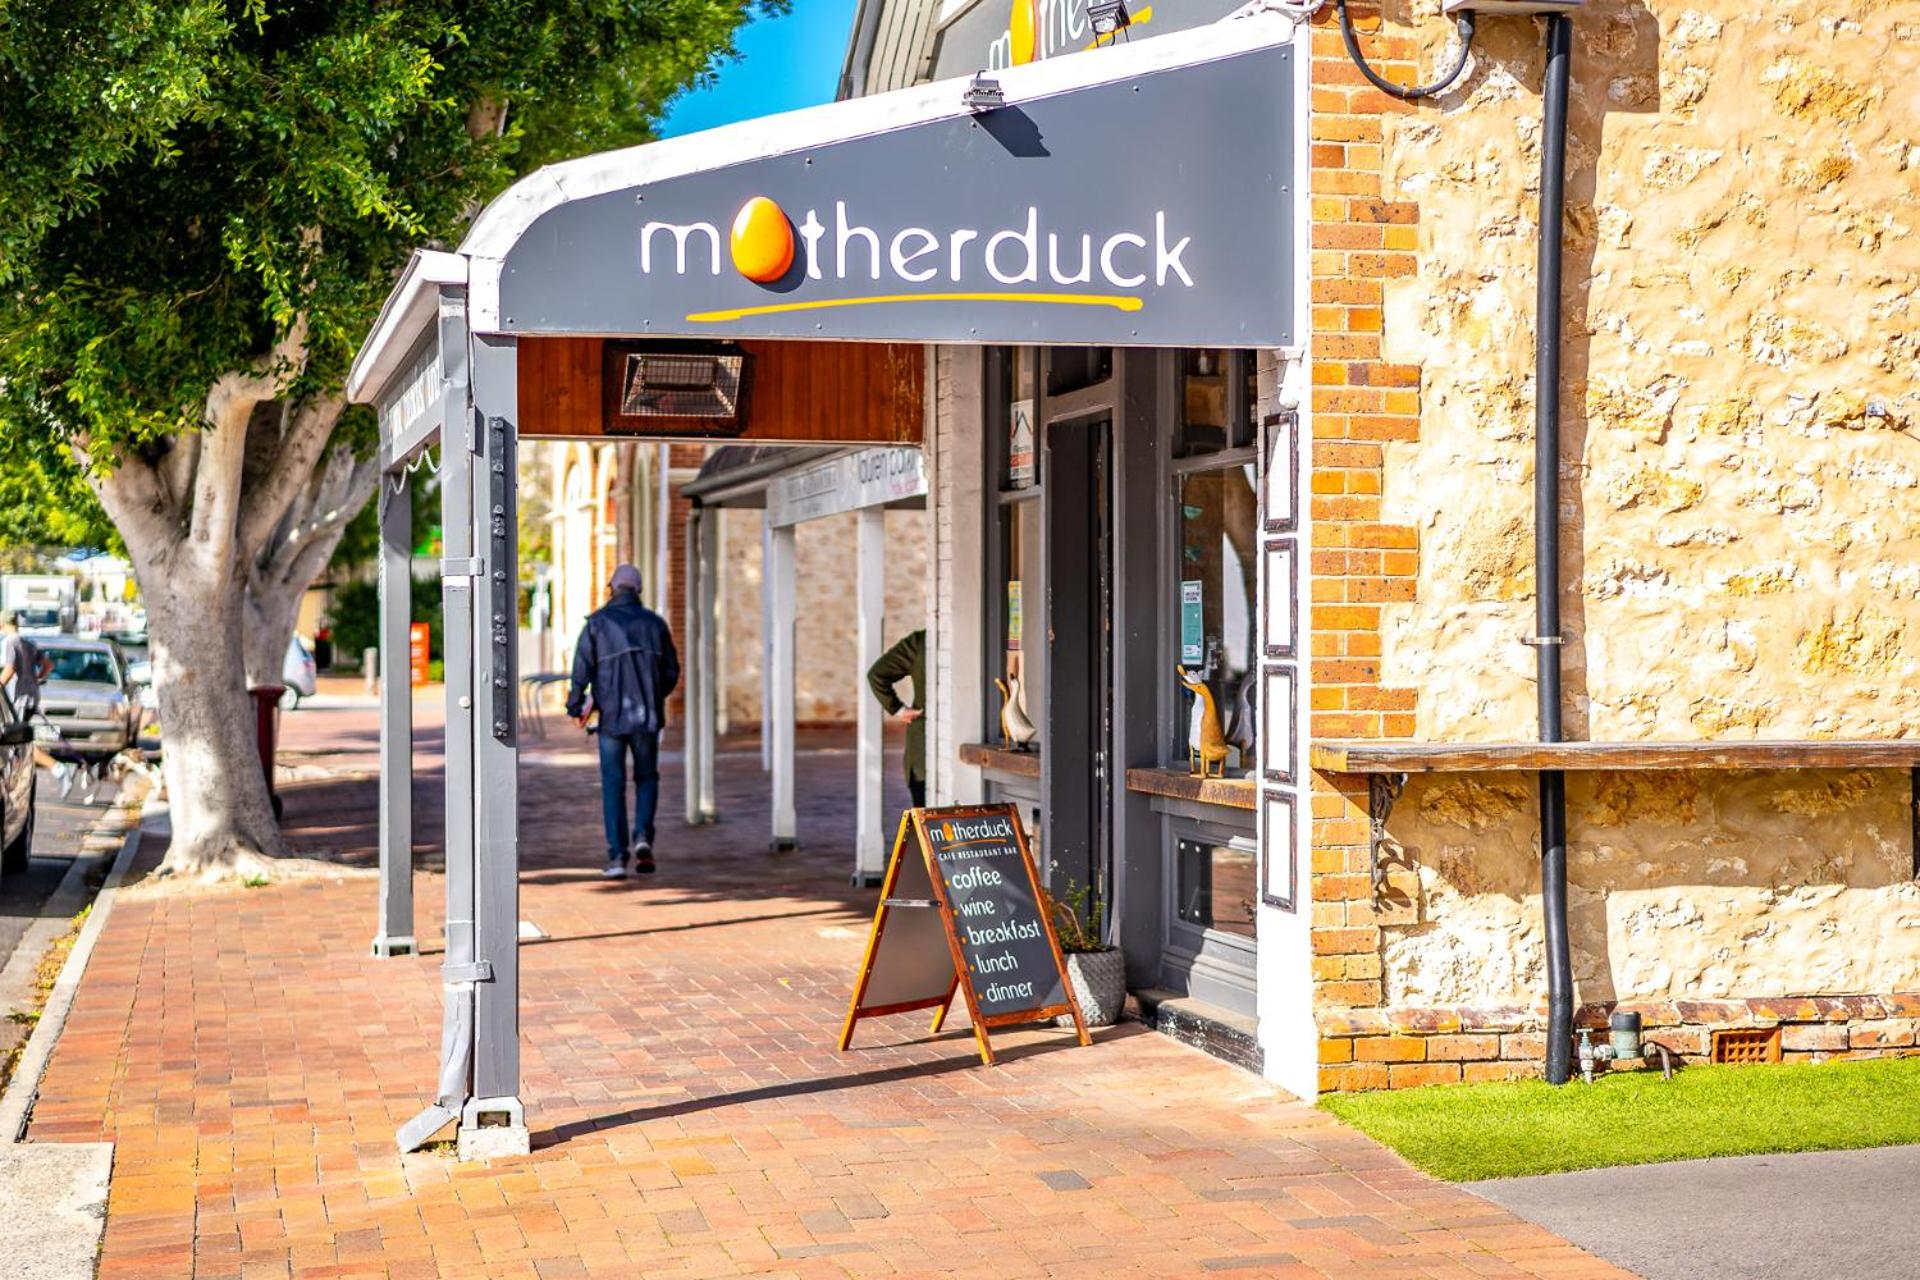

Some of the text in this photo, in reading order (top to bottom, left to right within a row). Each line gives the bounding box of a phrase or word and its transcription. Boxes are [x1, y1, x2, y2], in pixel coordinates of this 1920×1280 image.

[640, 196, 1193, 288] motherduck
[930, 819, 1014, 842] motherduck
[958, 847, 1002, 859] RESTAURANT
[1003, 846, 1018, 855] BAR
[952, 866, 1002, 889] coffee
[960, 897, 996, 917] wine
[967, 919, 1041, 945] breakfast
[975, 949, 1018, 974] lunch
[986, 981, 1033, 1002] dinner
